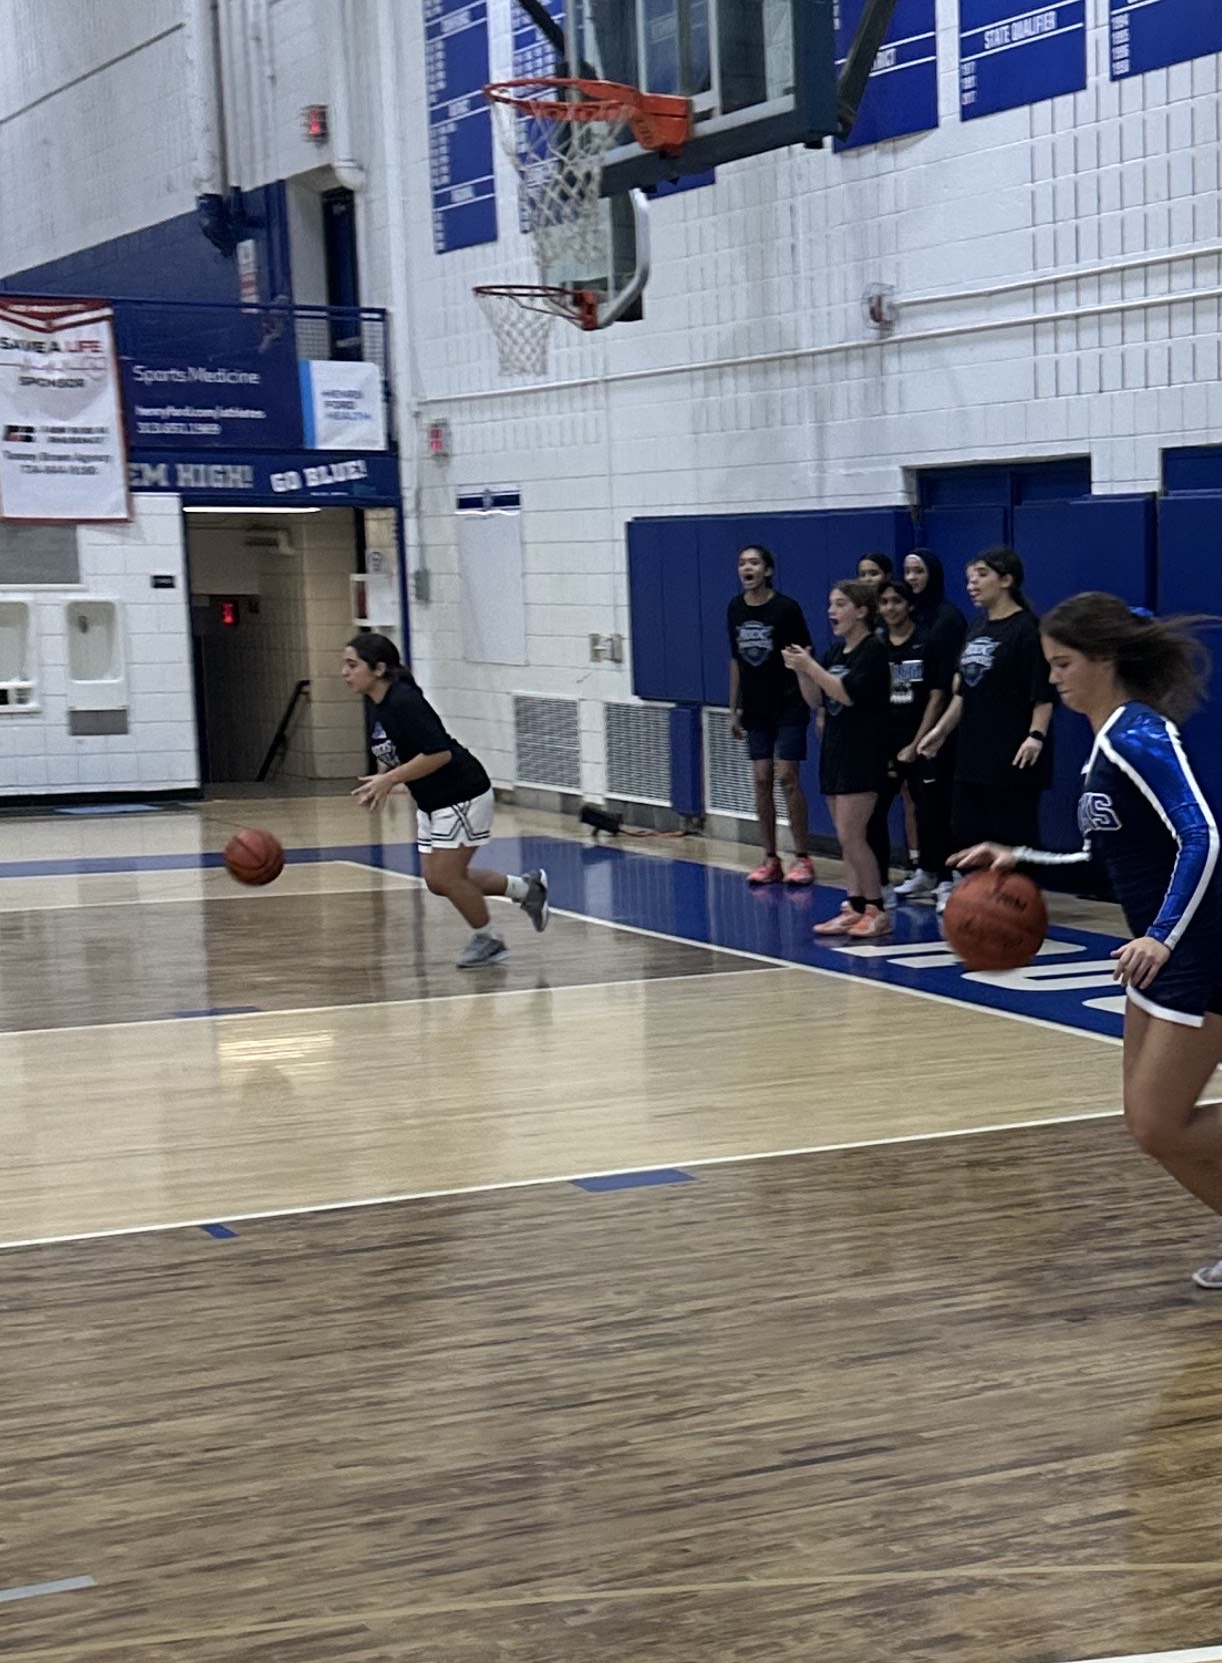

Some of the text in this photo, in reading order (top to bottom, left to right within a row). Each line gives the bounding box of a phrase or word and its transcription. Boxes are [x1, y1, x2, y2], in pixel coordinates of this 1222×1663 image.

[984, 10, 1057, 50] STATE QUALIFIER
[0, 337, 44, 353] SAVE
[65, 340, 102, 353] LIFE
[19, 376, 85, 388] SPONSOR
[132, 365, 261, 386] Sports Medicine
[176, 464, 254, 488] HIGH!
[270, 460, 368, 492] GO BLUE!
